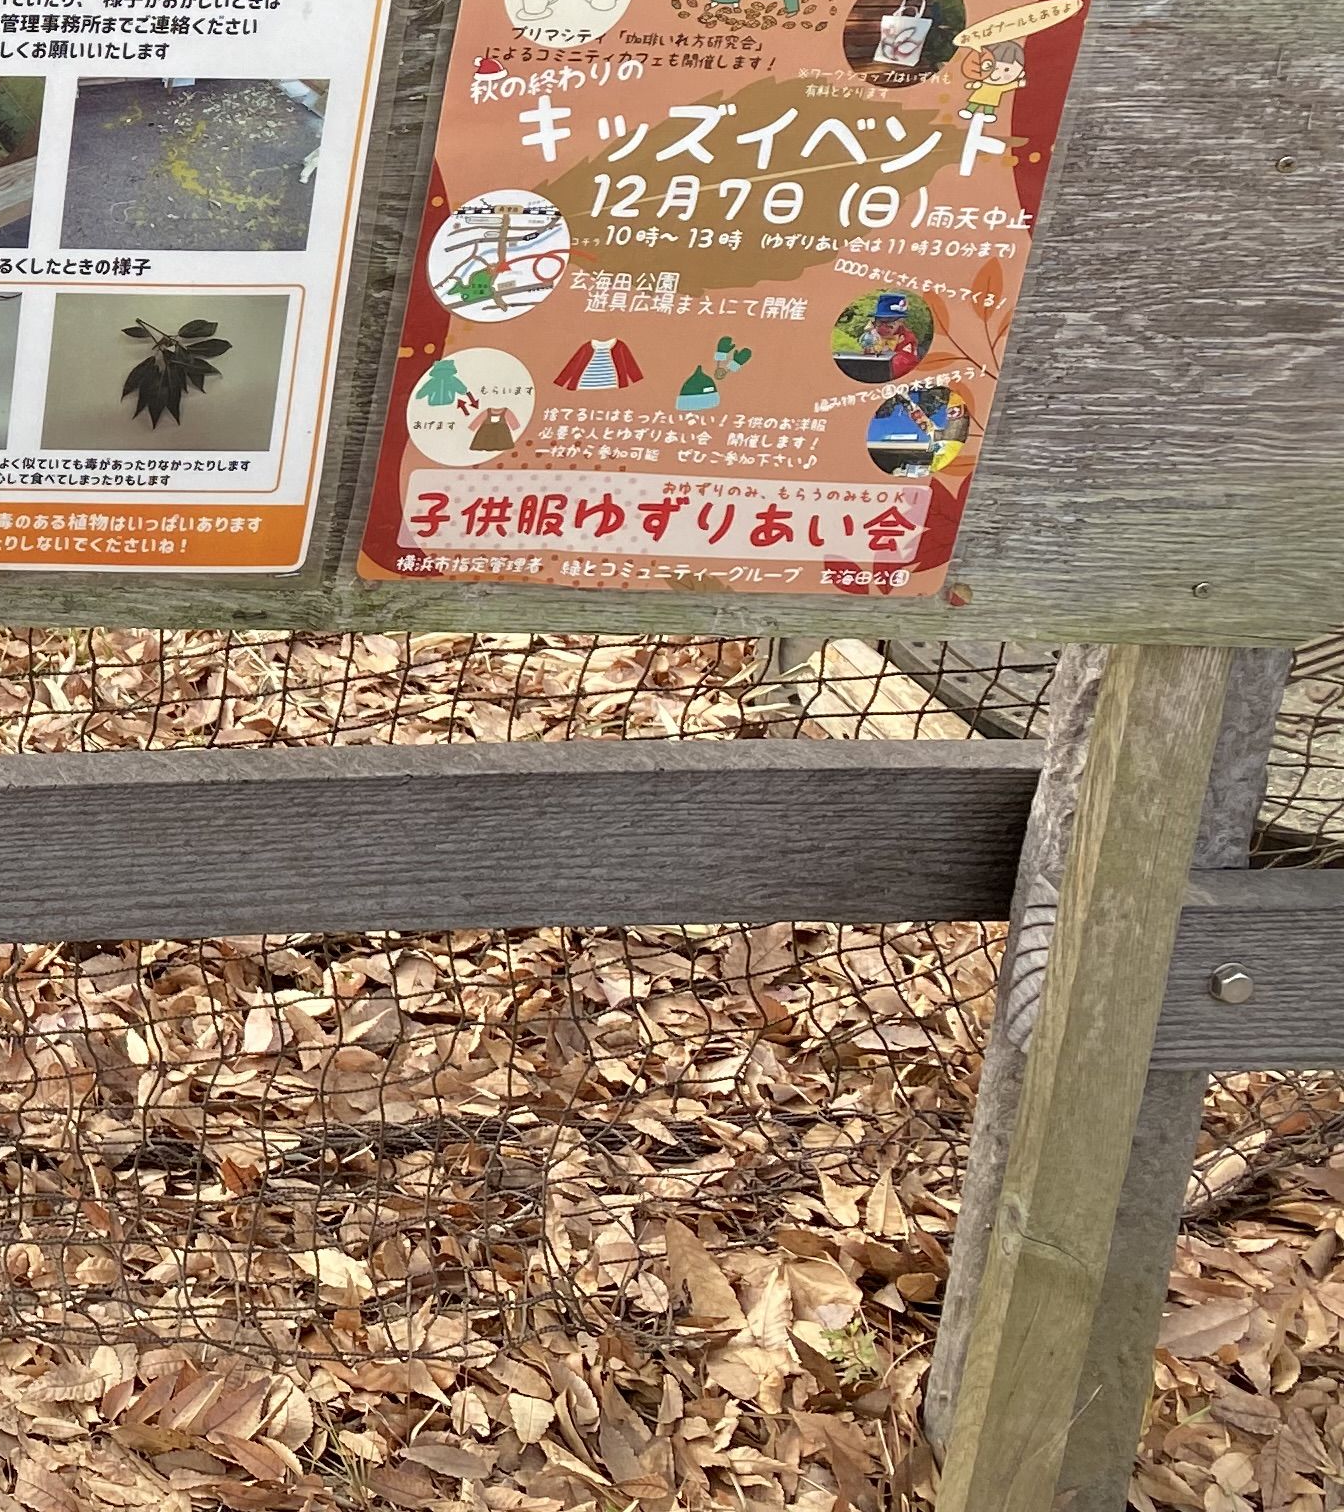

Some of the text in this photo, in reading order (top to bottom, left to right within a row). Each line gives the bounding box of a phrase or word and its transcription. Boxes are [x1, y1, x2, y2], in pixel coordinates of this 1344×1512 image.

[518, 94, 1007, 177] キッズイベント
[926, 204, 1033, 231] 雨天中止
[569, 270, 680, 294] 玄海田公園
[584, 292, 808, 321] 遊具広場まえにて開催
[480, 384, 534, 396] もらいます
[412, 419, 456, 431] あげます
[410, 492, 916, 552] 子供服ゆずりあい会
[396, 556, 909, 587] 横浜市指定管理者 緑とコミュニティーグループ 玄海田公園
